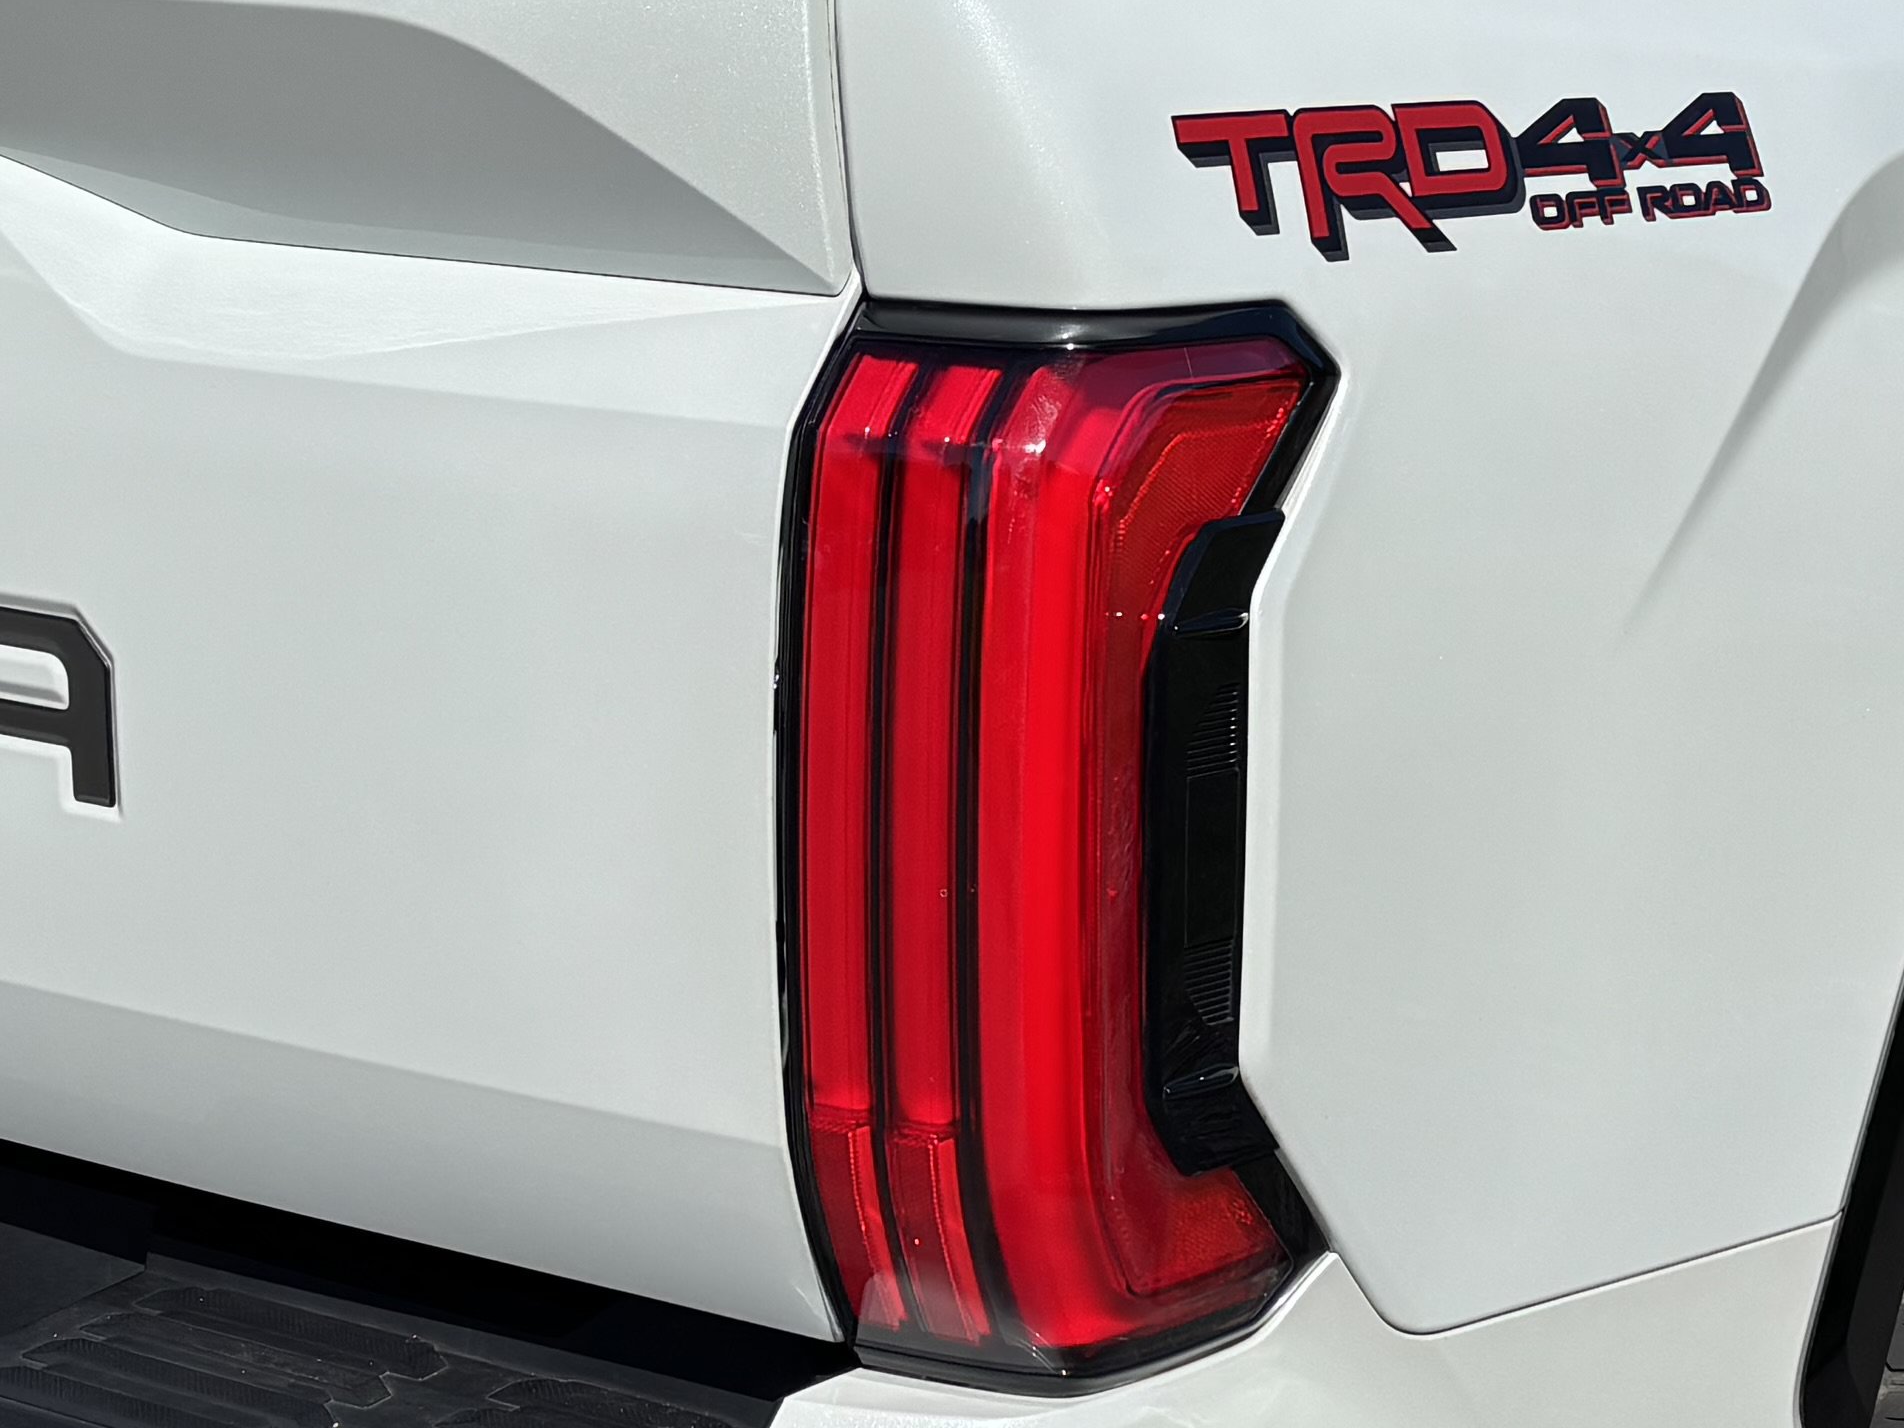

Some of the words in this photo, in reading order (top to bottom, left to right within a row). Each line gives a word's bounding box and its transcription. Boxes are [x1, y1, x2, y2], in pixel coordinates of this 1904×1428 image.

[1171, 99, 1525, 262] TRD
[1509, 91, 1764, 188] 4x4
[1529, 185, 1633, 231] OFF
[1636, 177, 1773, 223] ROAD
